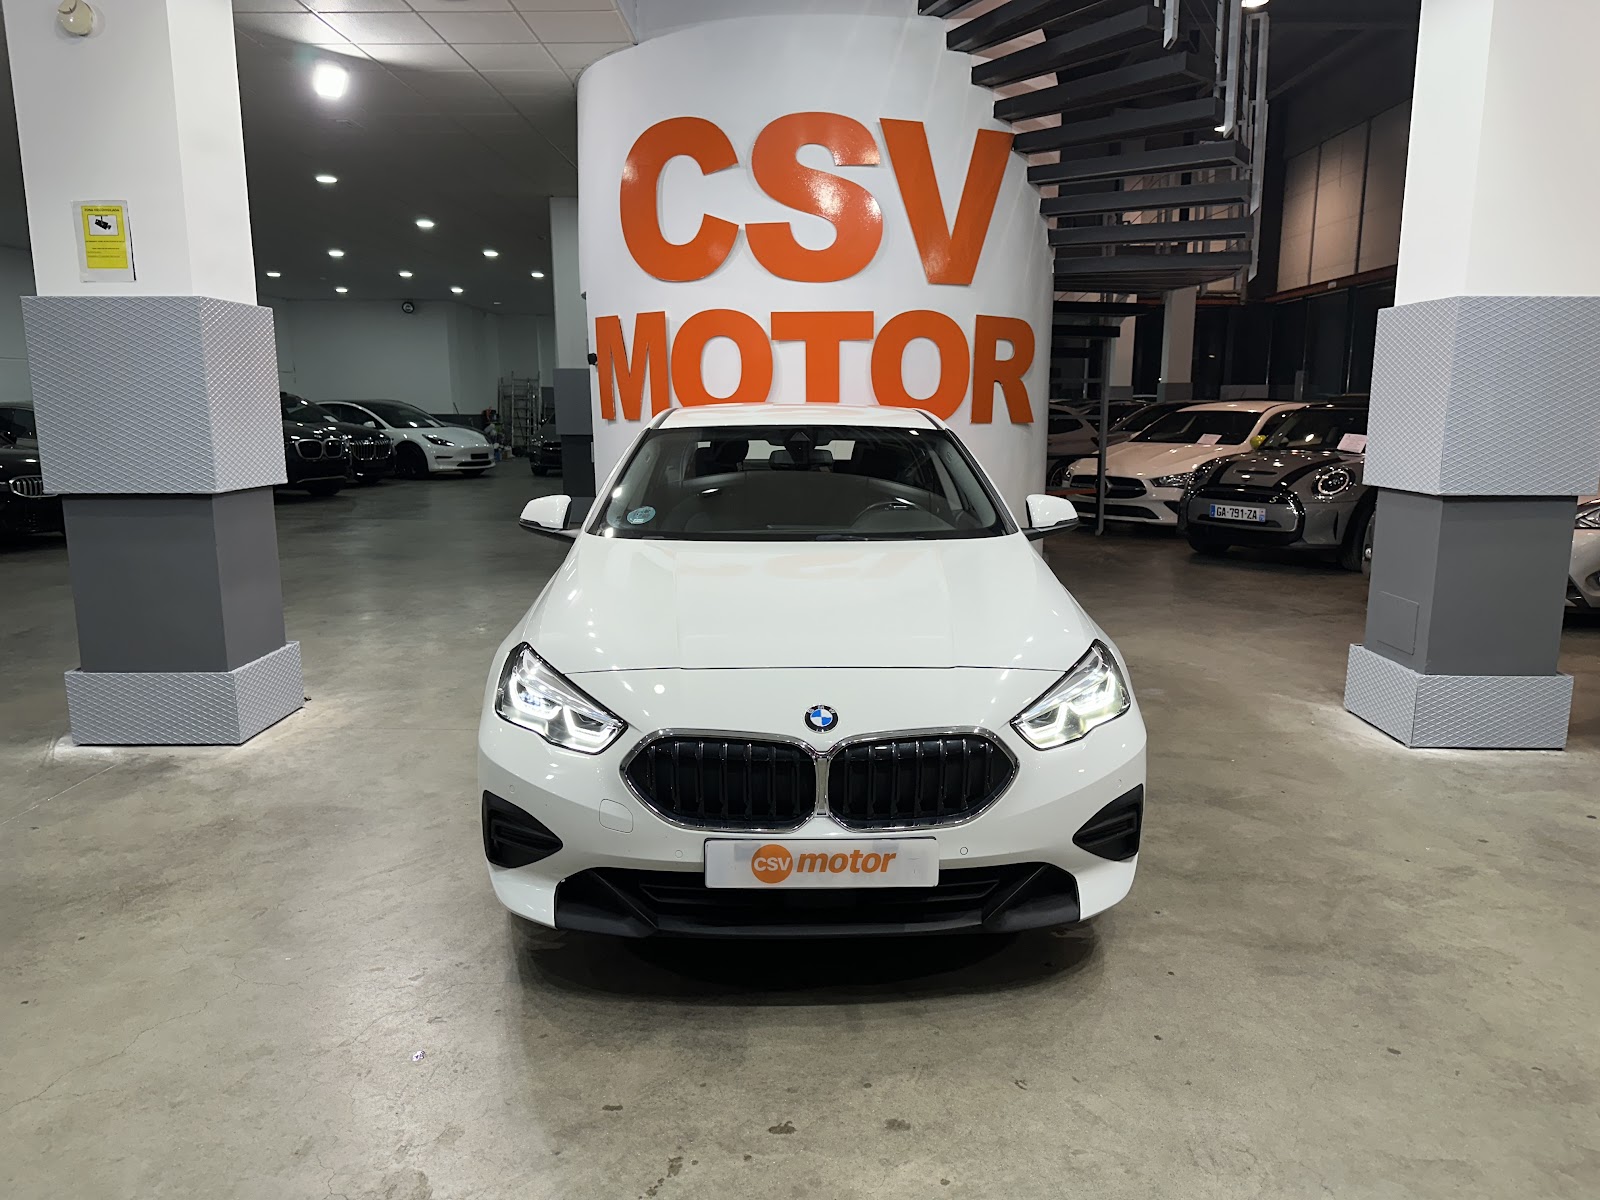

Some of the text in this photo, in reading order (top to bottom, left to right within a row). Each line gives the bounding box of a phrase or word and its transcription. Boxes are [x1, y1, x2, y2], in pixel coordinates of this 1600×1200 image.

[620, 111, 1015, 286] CSV
[595, 308, 1035, 424] MOTOR
[796, 849, 897, 874] motor
